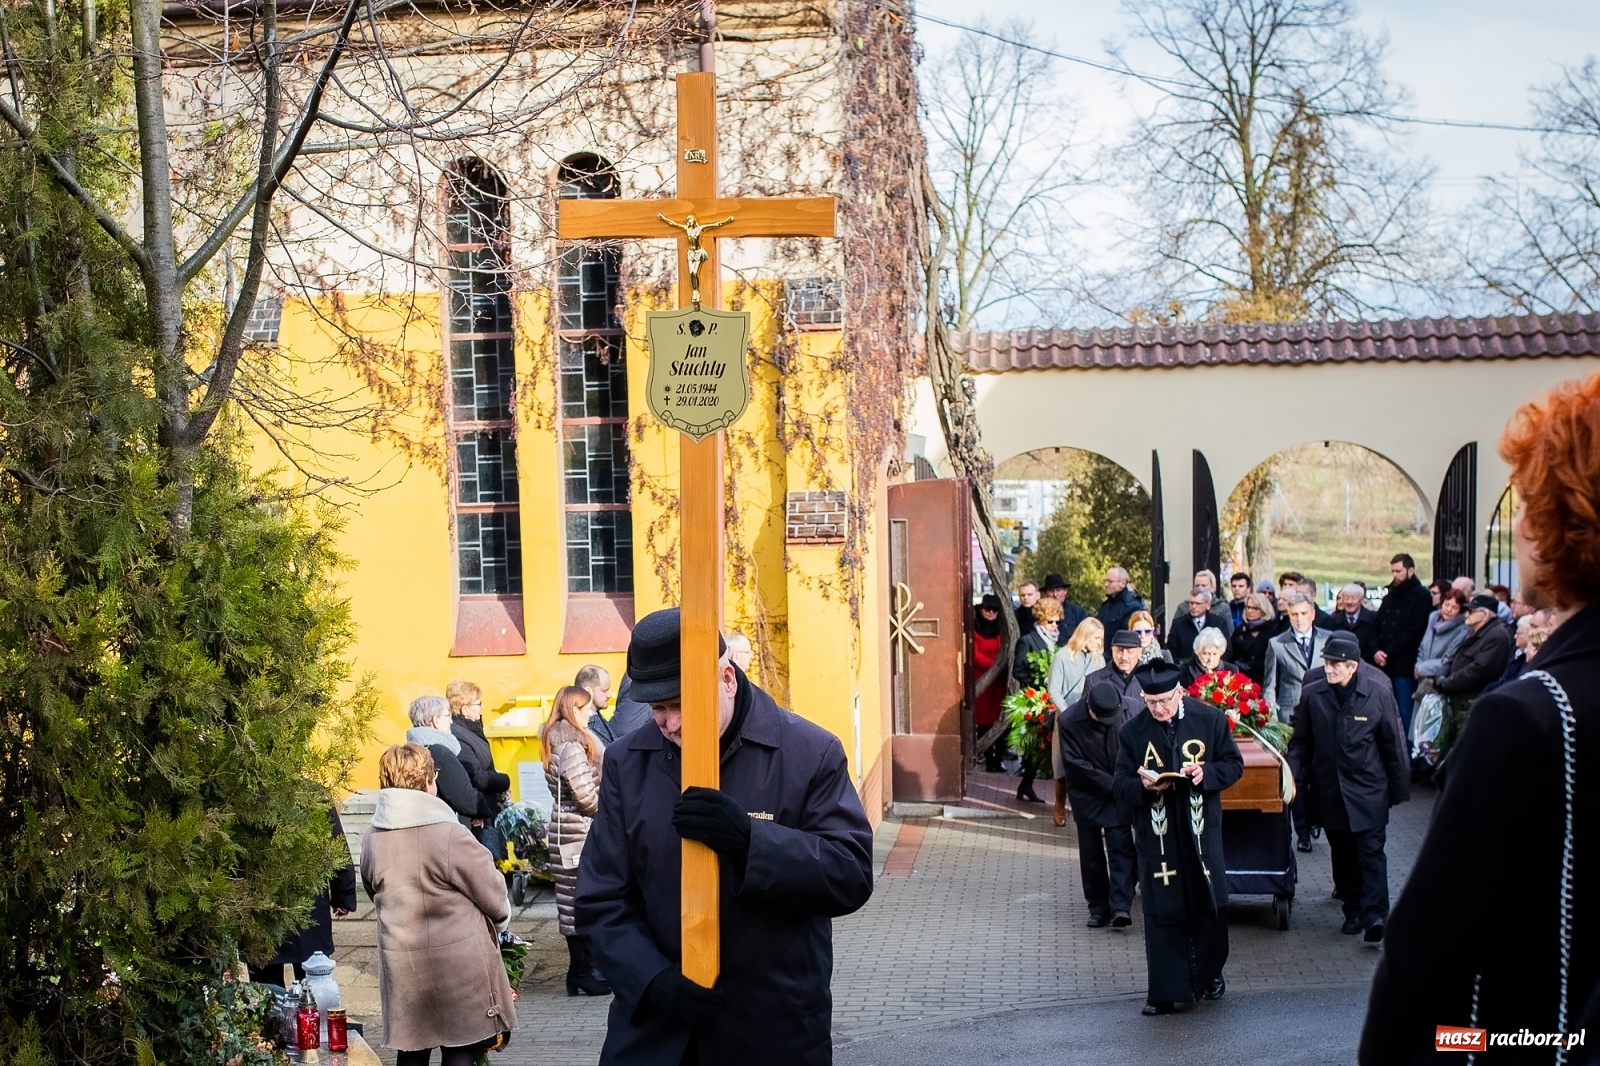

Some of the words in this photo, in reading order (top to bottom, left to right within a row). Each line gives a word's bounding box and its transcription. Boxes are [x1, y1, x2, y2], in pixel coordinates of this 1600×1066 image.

[684, 344, 707, 360] Jan
[675, 383, 717, 394] 21.05.1944
[675, 395, 720, 407] 29.01.2020
